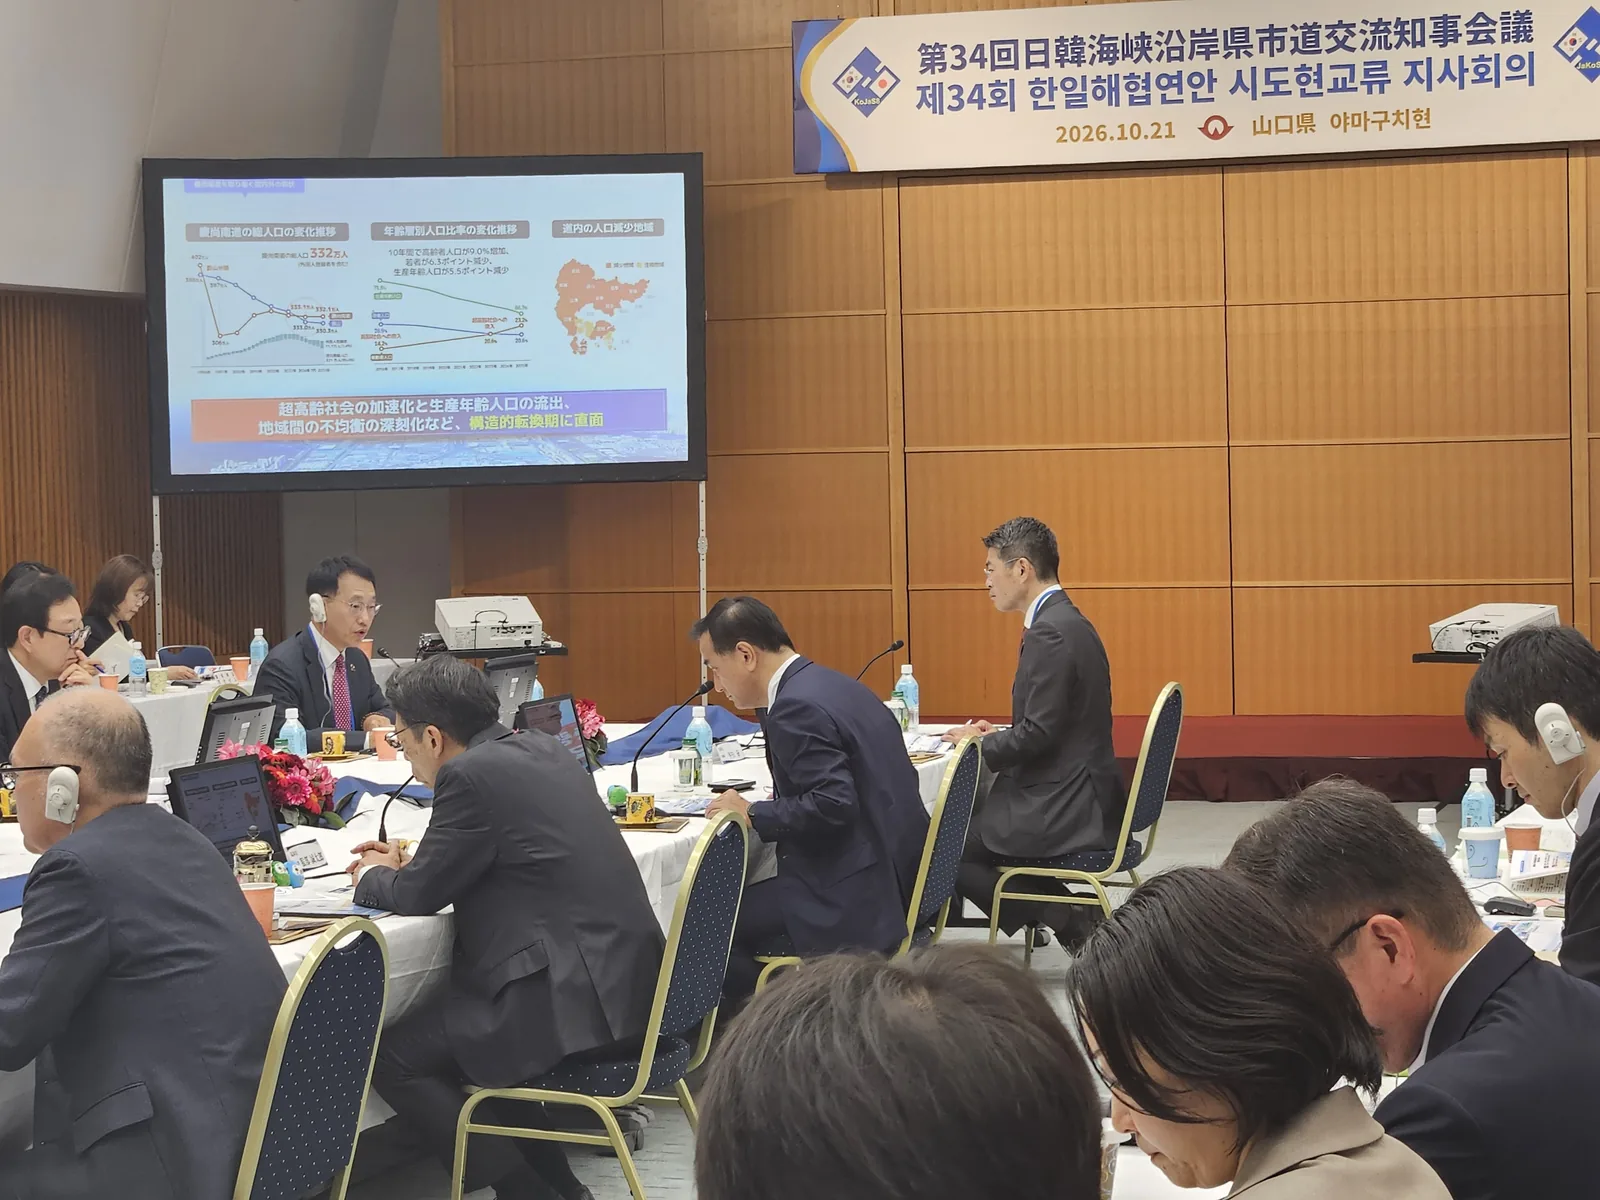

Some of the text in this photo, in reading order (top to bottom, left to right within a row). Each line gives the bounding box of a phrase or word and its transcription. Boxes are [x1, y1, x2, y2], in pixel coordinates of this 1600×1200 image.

[917, 9, 1534, 75] 第34回日韓海峡沿岸県市道交流知事会議
[916, 51, 1536, 115] 제34회 한일해협연안 시도현교류 지사회의
[1252, 112, 1316, 136] 山口県
[1330, 107, 1431, 133] 야마구치현
[1055, 121, 1176, 144] 2026.10.21
[562, 222, 655, 234] 道内の人口減少地域
[278, 396, 572, 417] 超高齢社会の加速化と生産年齢人口の流出、
